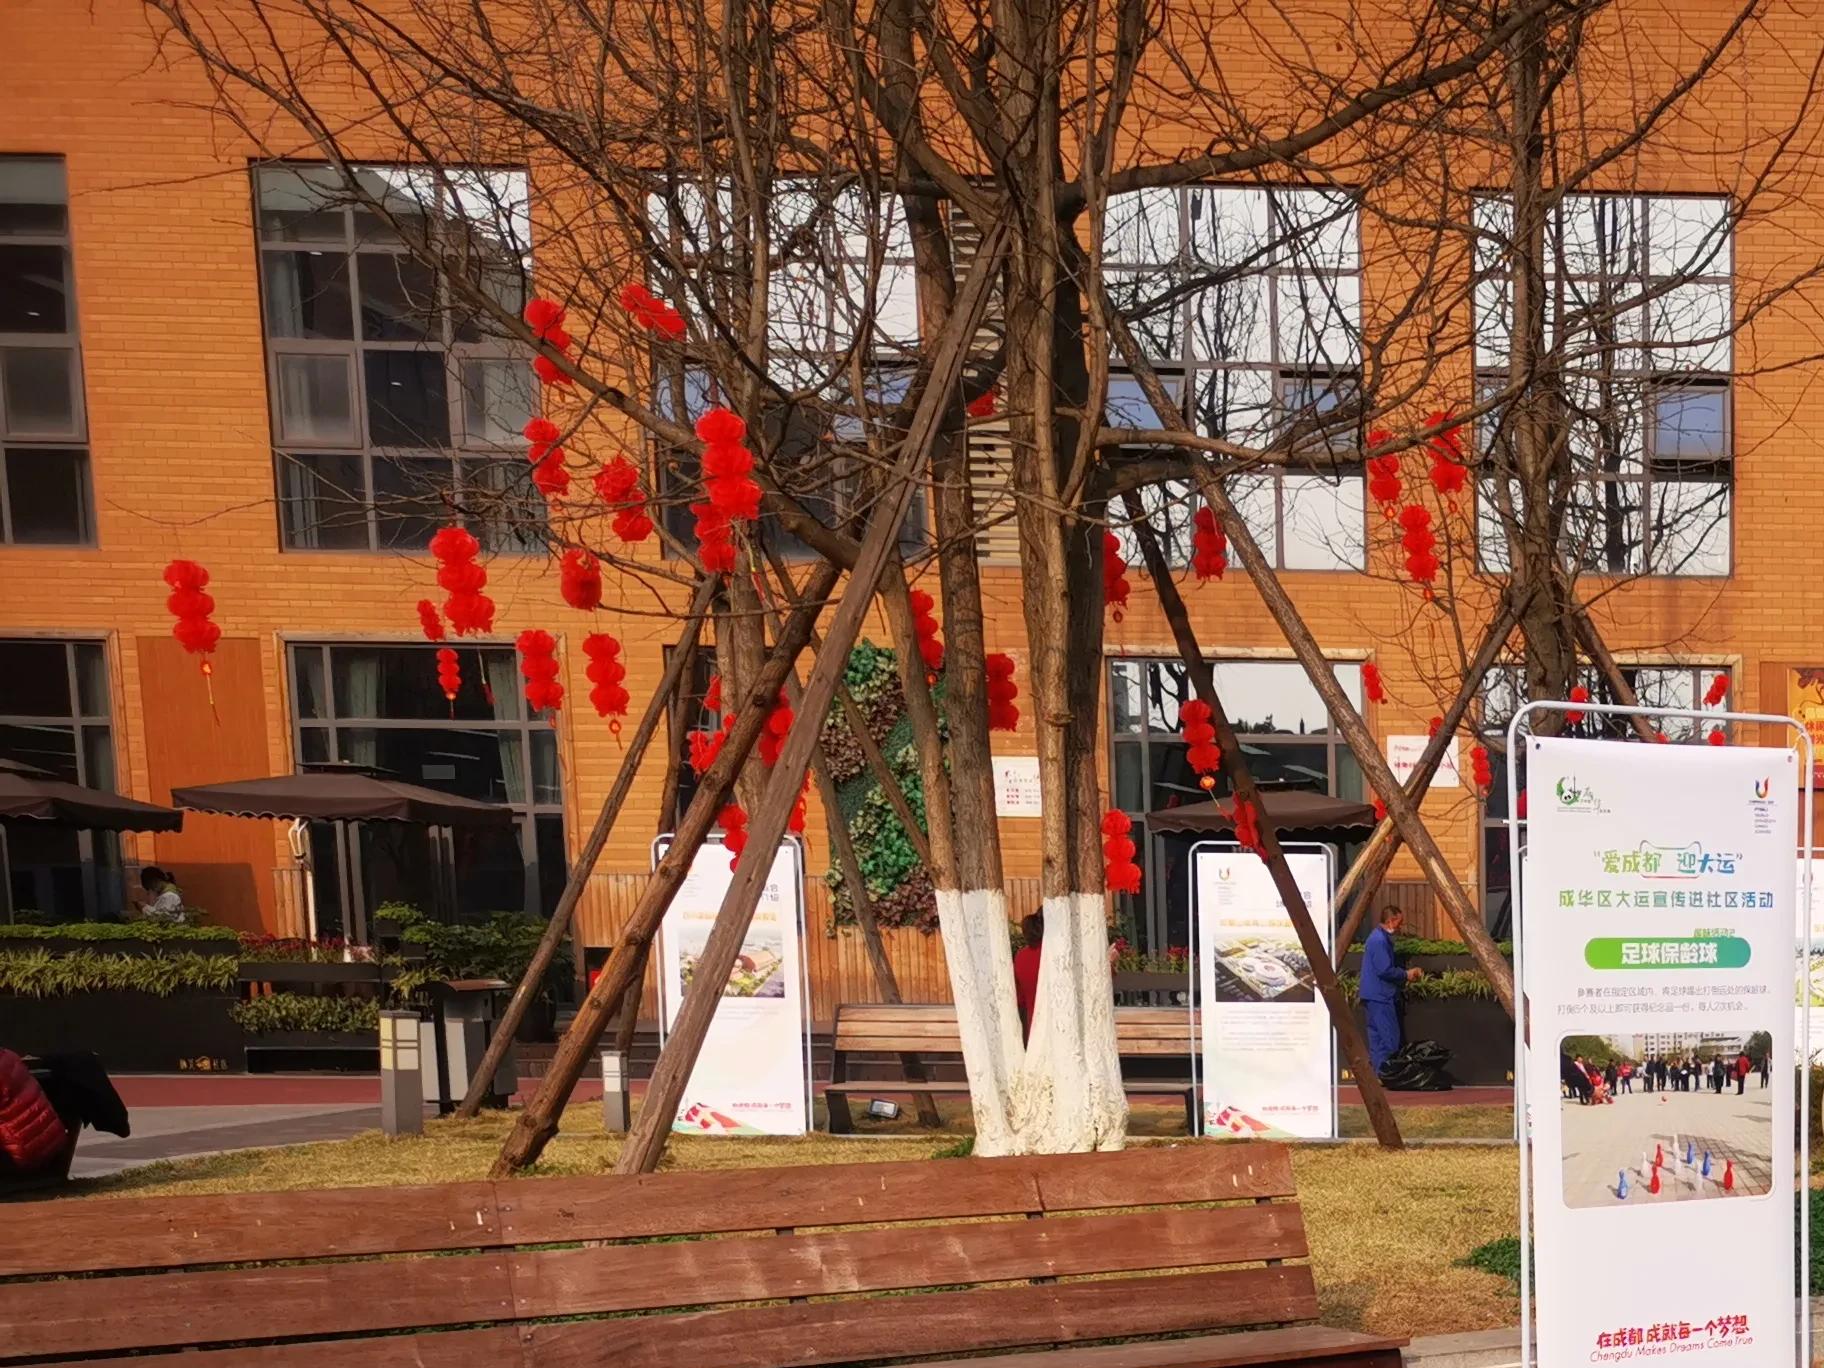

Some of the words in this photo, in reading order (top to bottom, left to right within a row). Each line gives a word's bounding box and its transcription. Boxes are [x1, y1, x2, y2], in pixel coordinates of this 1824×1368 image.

[1559, 889, 1774, 909] 成华区大运宣传进社区活动
[1621, 942, 1718, 965] 足球保龄球
[1596, 1327, 1644, 1349] 在成都
[1646, 1315, 1750, 1343] 成就每一个梦想
[1589, 1350, 1633, 1363] Chengdu
[1635, 1344, 1667, 1357] Makes
[1670, 1341, 1705, 1354] Dreams
[1707, 1336, 1733, 1349] Come
